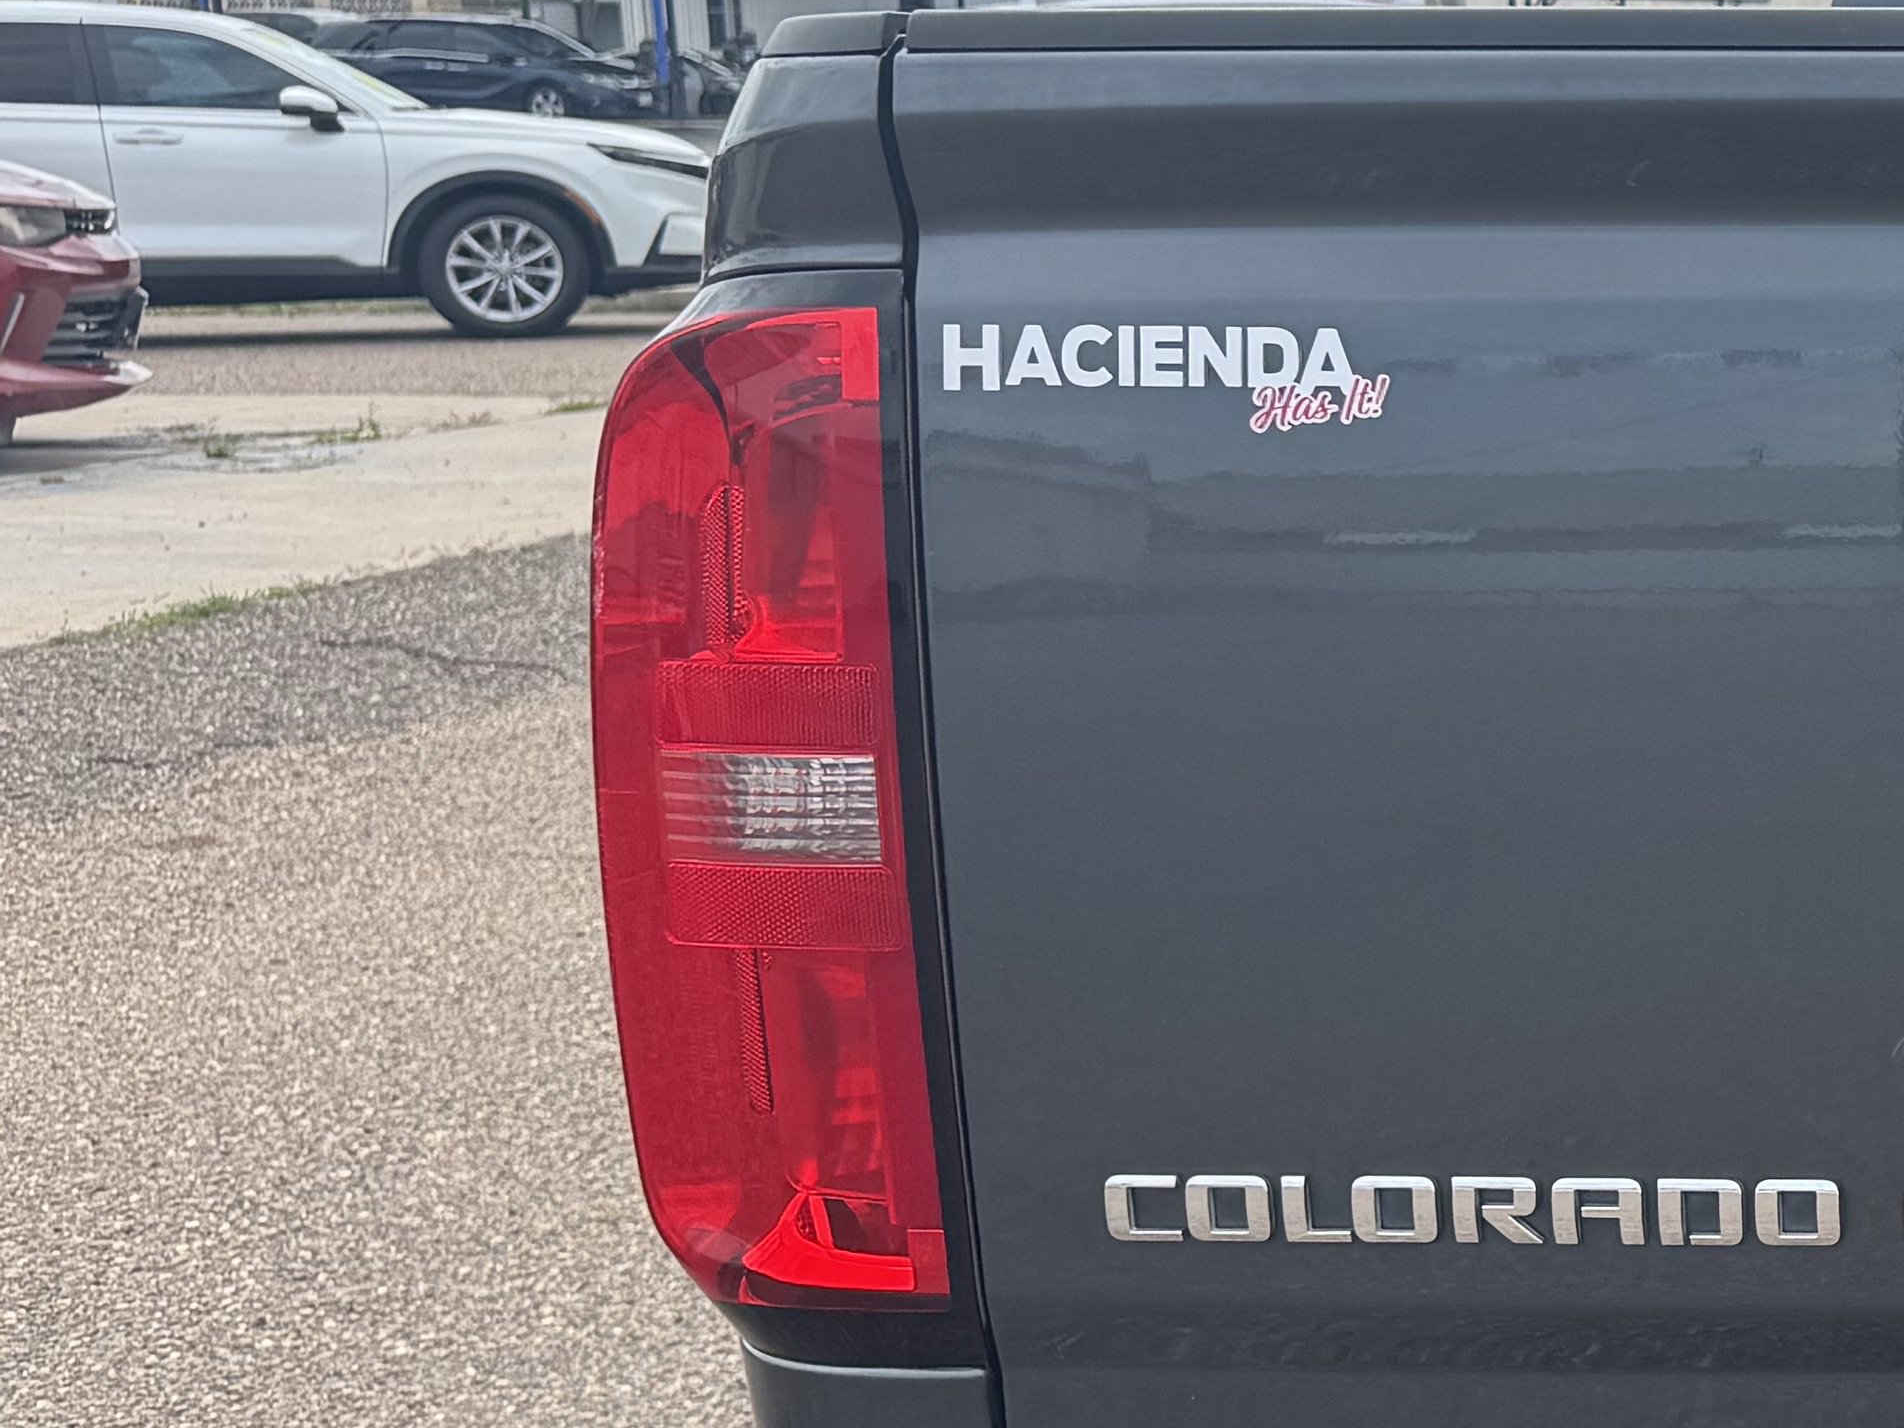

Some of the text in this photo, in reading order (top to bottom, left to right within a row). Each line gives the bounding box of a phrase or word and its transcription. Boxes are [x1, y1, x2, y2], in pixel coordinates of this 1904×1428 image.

[943, 323, 1355, 393] HACIENDA
[1250, 383, 1338, 433] Has
[1104, 1174, 1842, 1246] COLORADO
